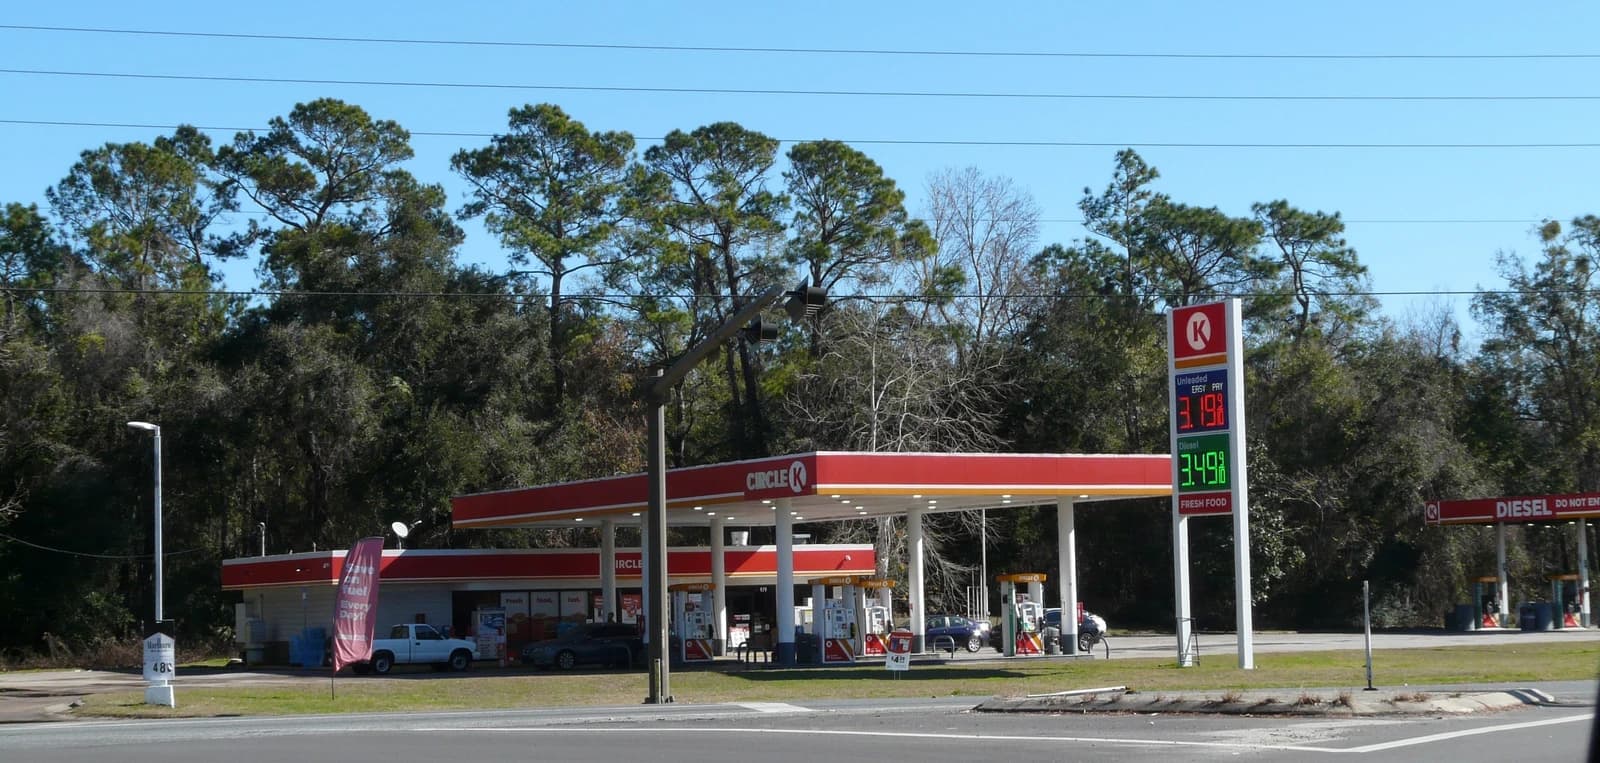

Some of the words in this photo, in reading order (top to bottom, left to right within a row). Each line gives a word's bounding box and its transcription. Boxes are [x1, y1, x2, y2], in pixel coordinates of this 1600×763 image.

[1190, 315, 1211, 348] K
[1177, 375, 1207, 385] Unleaded
[1191, 385, 1206, 393] EASY
[1212, 382, 1223, 391] PAY
[1179, 441, 1199, 449] Diesel
[746, 469, 788, 491] CIRCLE
[791, 464, 805, 491] K
[1180, 500, 1204, 509] FRESH
[1206, 498, 1227, 507] FOOD
[1496, 499, 1552, 517] DIESEL
[1569, 498, 1586, 507] NOT
[616, 560, 642, 568] IRCLE
[341, 600, 371, 613] Every
